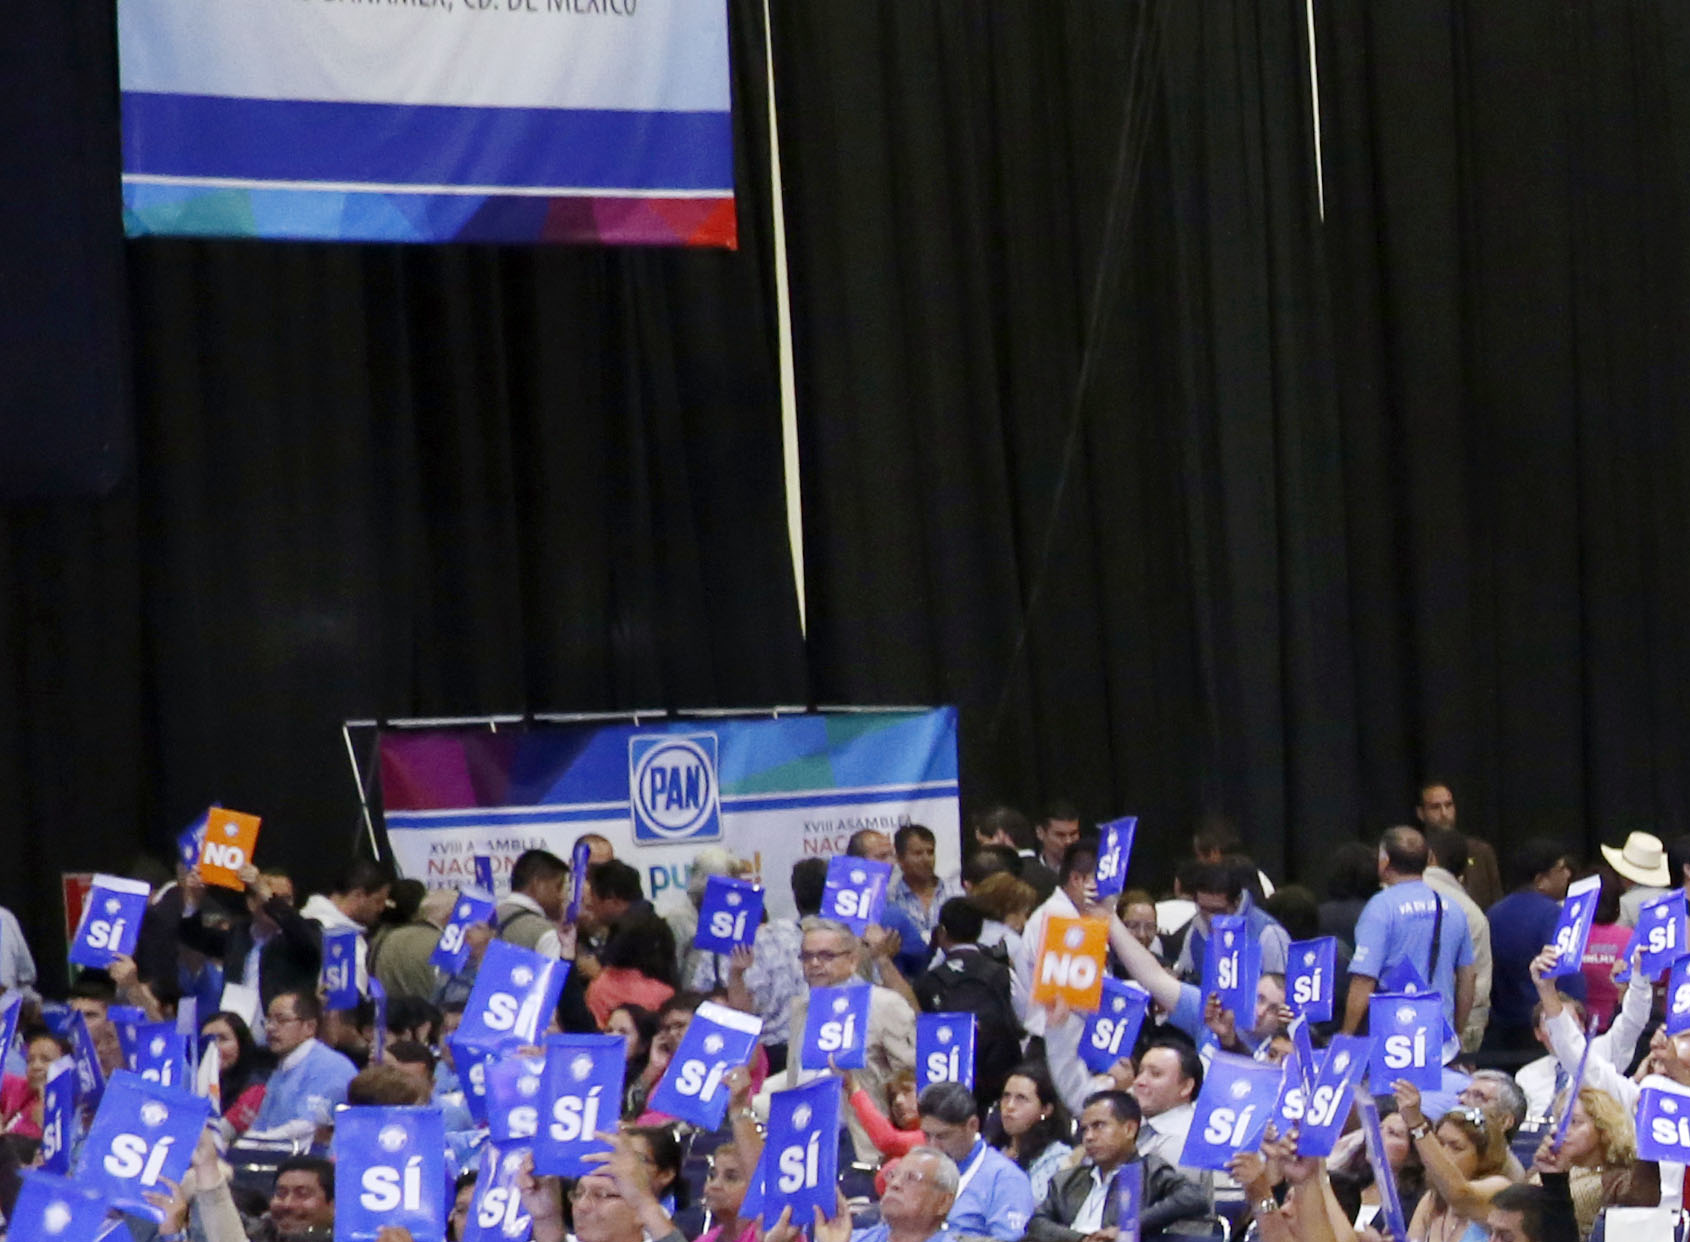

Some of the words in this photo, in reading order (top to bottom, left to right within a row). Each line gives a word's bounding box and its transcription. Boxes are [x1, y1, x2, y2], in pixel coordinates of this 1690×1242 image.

[650, 765, 702, 810] PAN
[204, 842, 250, 870] NO
[1097, 842, 1121, 880] SÍ
[835, 889, 870, 918] SÍ
[87, 918, 126, 951] SÍ
[440, 916, 470, 954] SÍ
[710, 911, 747, 940] SÍ
[1552, 921, 1584, 957] SÍ
[1649, 917, 1675, 953] SÍ
[1041, 951, 1097, 989] NO
[1218, 952, 1238, 989] SÍ
[1294, 968, 1322, 1003] SÍ
[818, 1014, 855, 1050] SÍ
[1092, 1018, 1128, 1054] SÍ
[1385, 1027, 1427, 1068] SÍ
[676, 1060, 735, 1102] SÍ
[927, 1046, 959, 1083] SÍ
[550, 1086, 610, 1141] SÍ
[1307, 1078, 1348, 1126] SÍ
[43, 1110, 62, 1159] SÍ
[1205, 1104, 1256, 1146] SÍ
[1653, 1117, 1690, 1147] SÍ
[104, 1134, 174, 1186] SÍ
[779, 1131, 820, 1193] SÍ
[361, 1156, 430, 1214] SÍ
